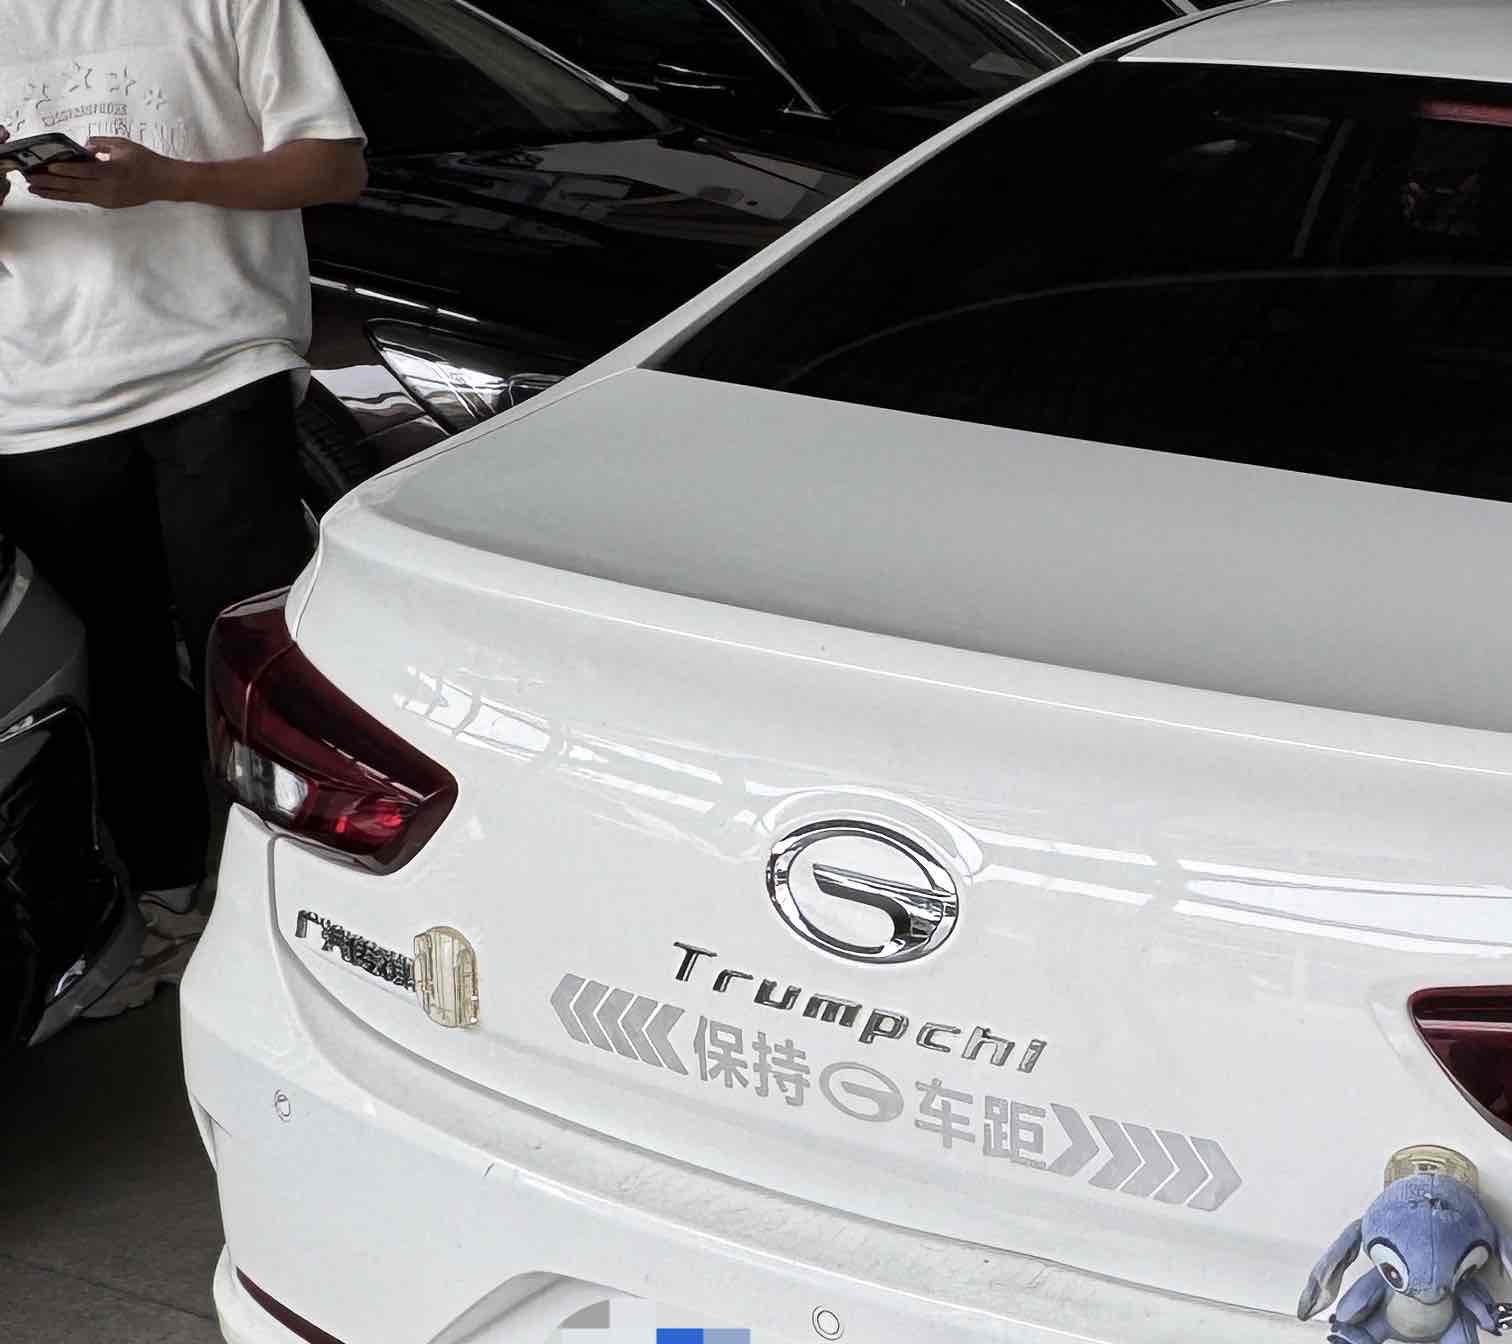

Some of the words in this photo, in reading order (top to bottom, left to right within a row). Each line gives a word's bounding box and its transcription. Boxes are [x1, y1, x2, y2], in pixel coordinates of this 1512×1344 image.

[672, 941, 1046, 1073] Trumpchi
[693, 1015, 811, 1106] 保持
[915, 1078, 1047, 1169] 车距
